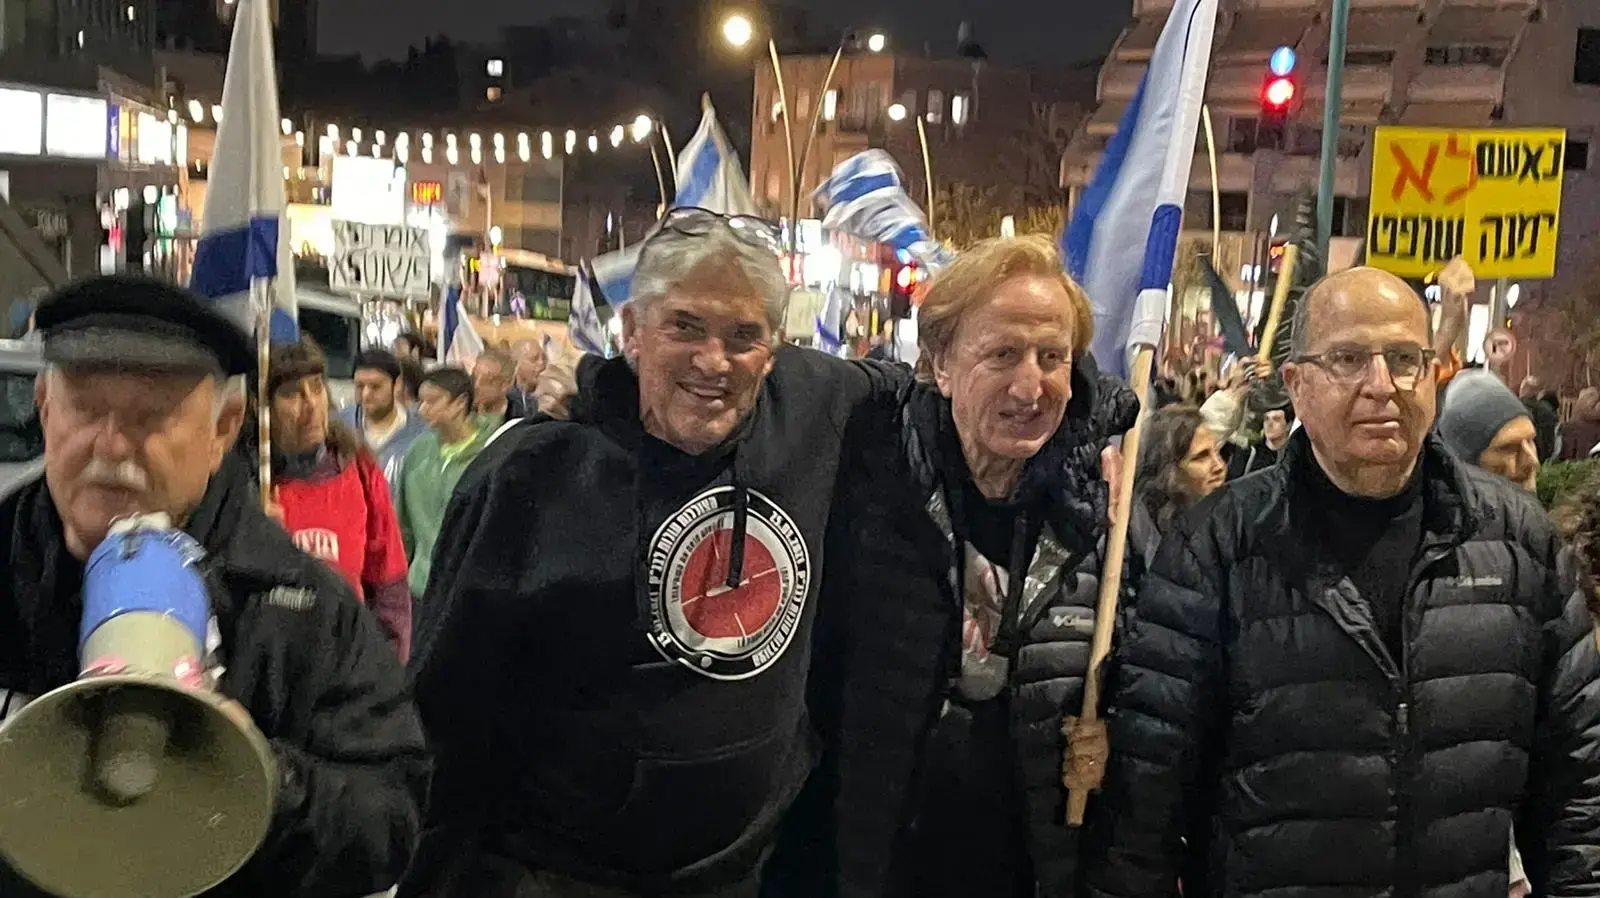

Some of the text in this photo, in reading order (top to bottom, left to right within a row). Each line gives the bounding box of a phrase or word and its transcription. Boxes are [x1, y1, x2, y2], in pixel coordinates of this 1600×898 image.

[1389, 131, 1562, 205] נאשם לא
[1368, 212, 1556, 264] ימנה שופט
